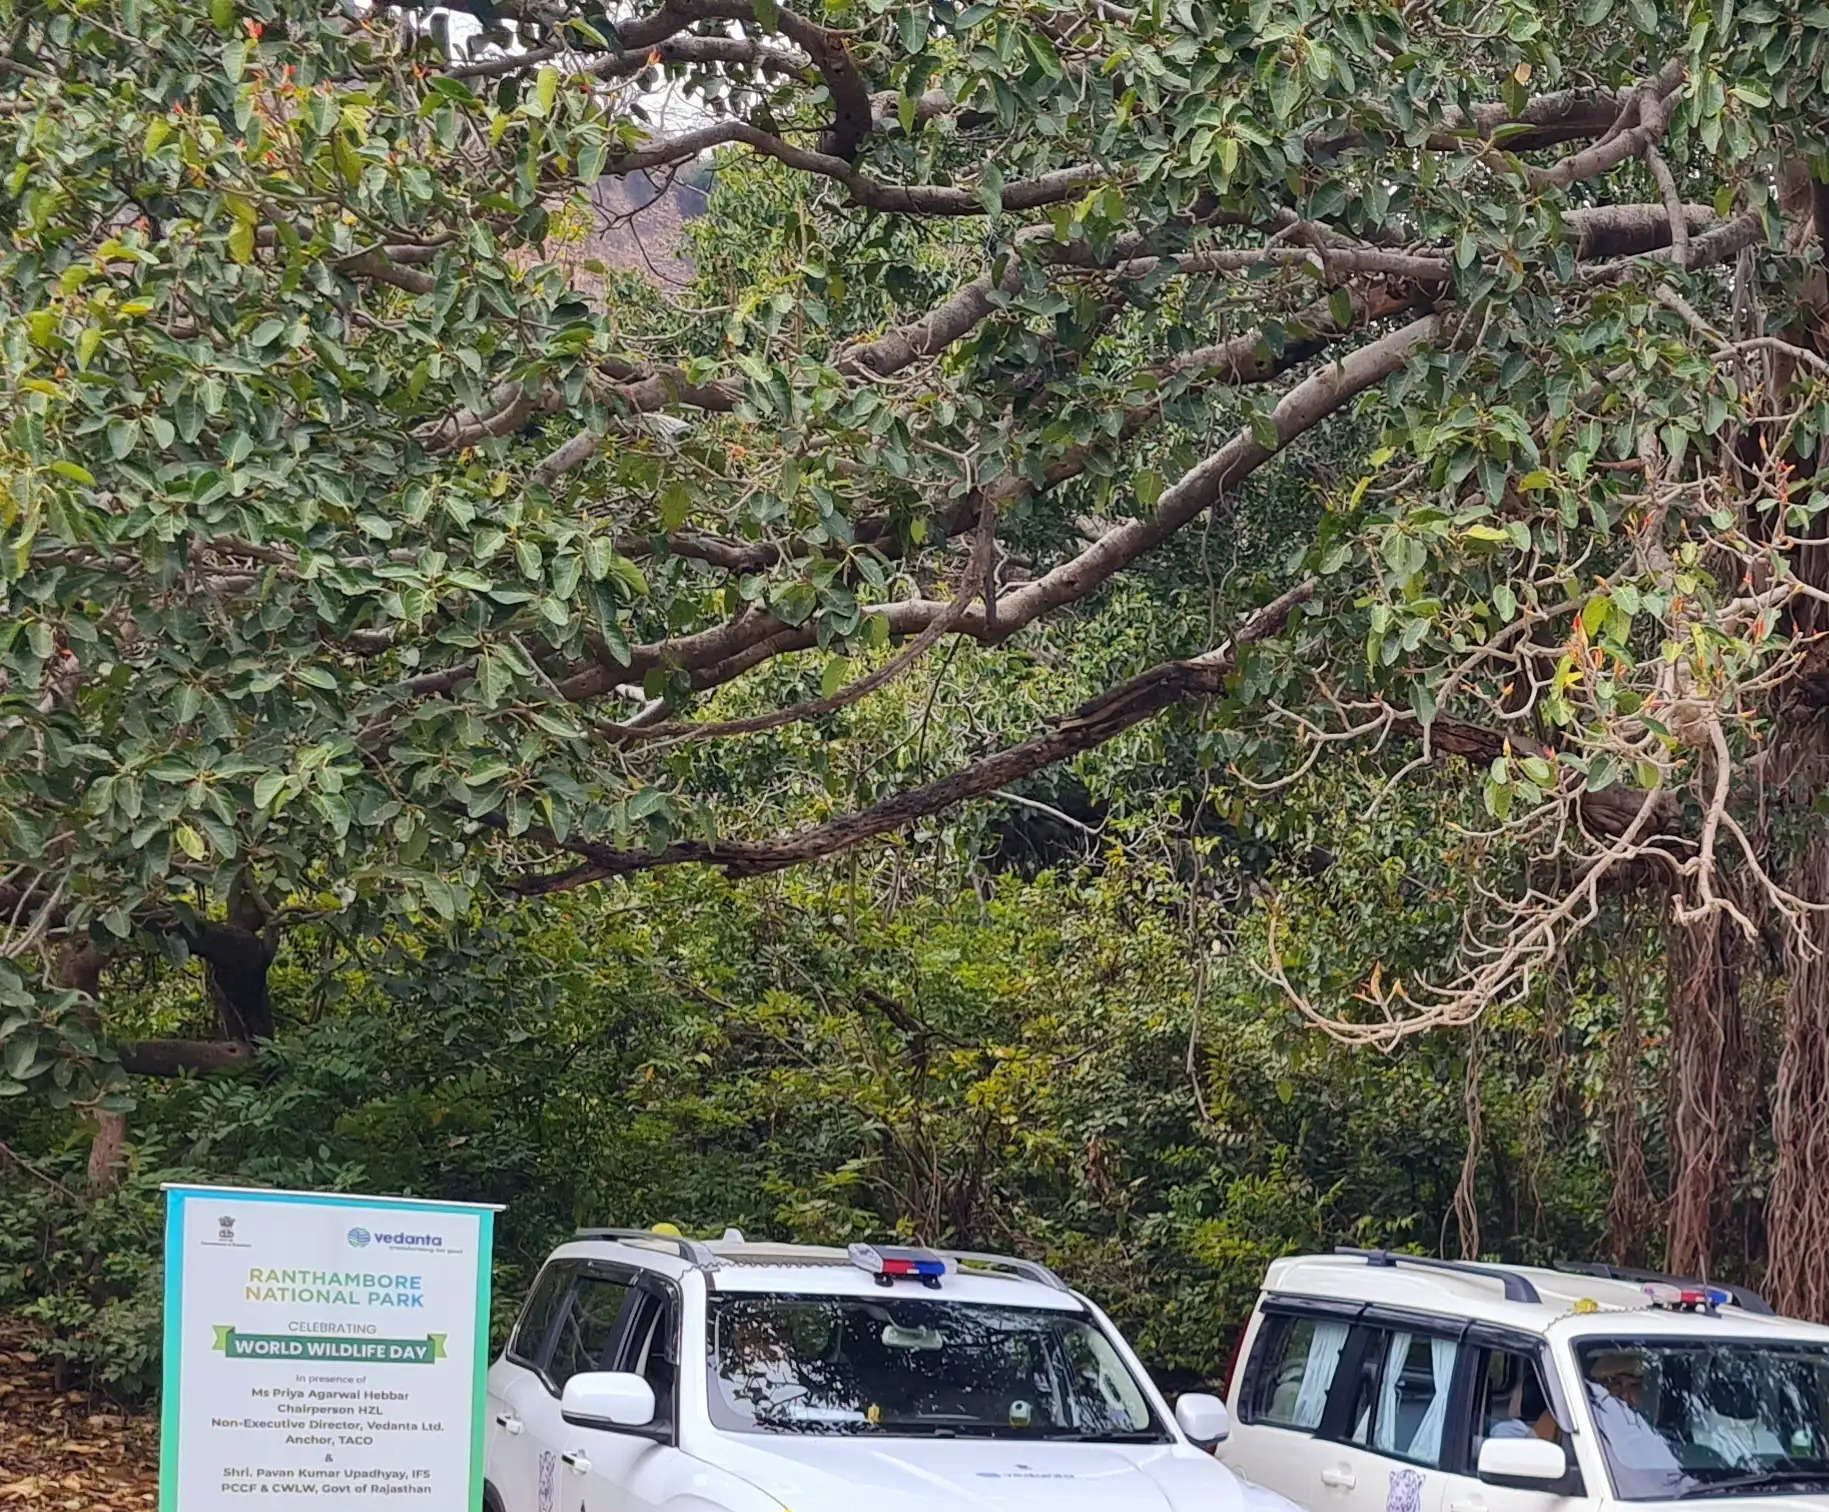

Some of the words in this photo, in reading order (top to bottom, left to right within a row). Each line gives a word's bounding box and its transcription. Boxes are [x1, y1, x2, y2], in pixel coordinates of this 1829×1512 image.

[374, 1231, 443, 1247] vedanta
[249, 1268, 422, 1290] RANTHAMBORE
[245, 1286, 361, 1305] NATIONAL
[368, 1291, 424, 1308] PARK
[288, 1321, 377, 1335] CELEBRATING
[235, 1339, 302, 1356] WORLD
[307, 1341, 386, 1358] WILDLIFE
[390, 1344, 427, 1360] DAY
[296, 1374, 306, 1383] In
[308, 1375, 354, 1385] presence
[356, 1375, 367, 1384] of
[251, 1388, 269, 1398] Ms
[273, 1388, 305, 1400] Priya
[308, 1389, 360, 1401] Agarwal
[364, 1390, 409, 1401] Hebbar
[277, 1404, 354, 1416] Chairperson
[358, 1405, 383, 1415] HZL
[211, 1417, 305, 1430] Non-Executive
[309, 1419, 364, 1432] Director,
[367, 1421, 418, 1432] Vedanta
[421, 1421, 444, 1432] Ltd.
[285, 1434, 335, 1446] Anchor,
[338, 1435, 374, 1446] TACO
[324, 1453, 334, 1463] &
[256, 1468, 294, 1478] Pavan
[298, 1469, 340, 1478] Kumar
[343, 1469, 409, 1481] Upadhyay,
[412, 1469, 430, 1479] IFS
[221, 1483, 256, 1493] PCCF
[260, 1483, 269, 1493] &
[271, 1483, 318, 1494] CWLW,
[322, 1484, 351, 1493] Govt
[355, 1483, 367, 1493] of
[371, 1484, 432, 1495] Rajasthan
